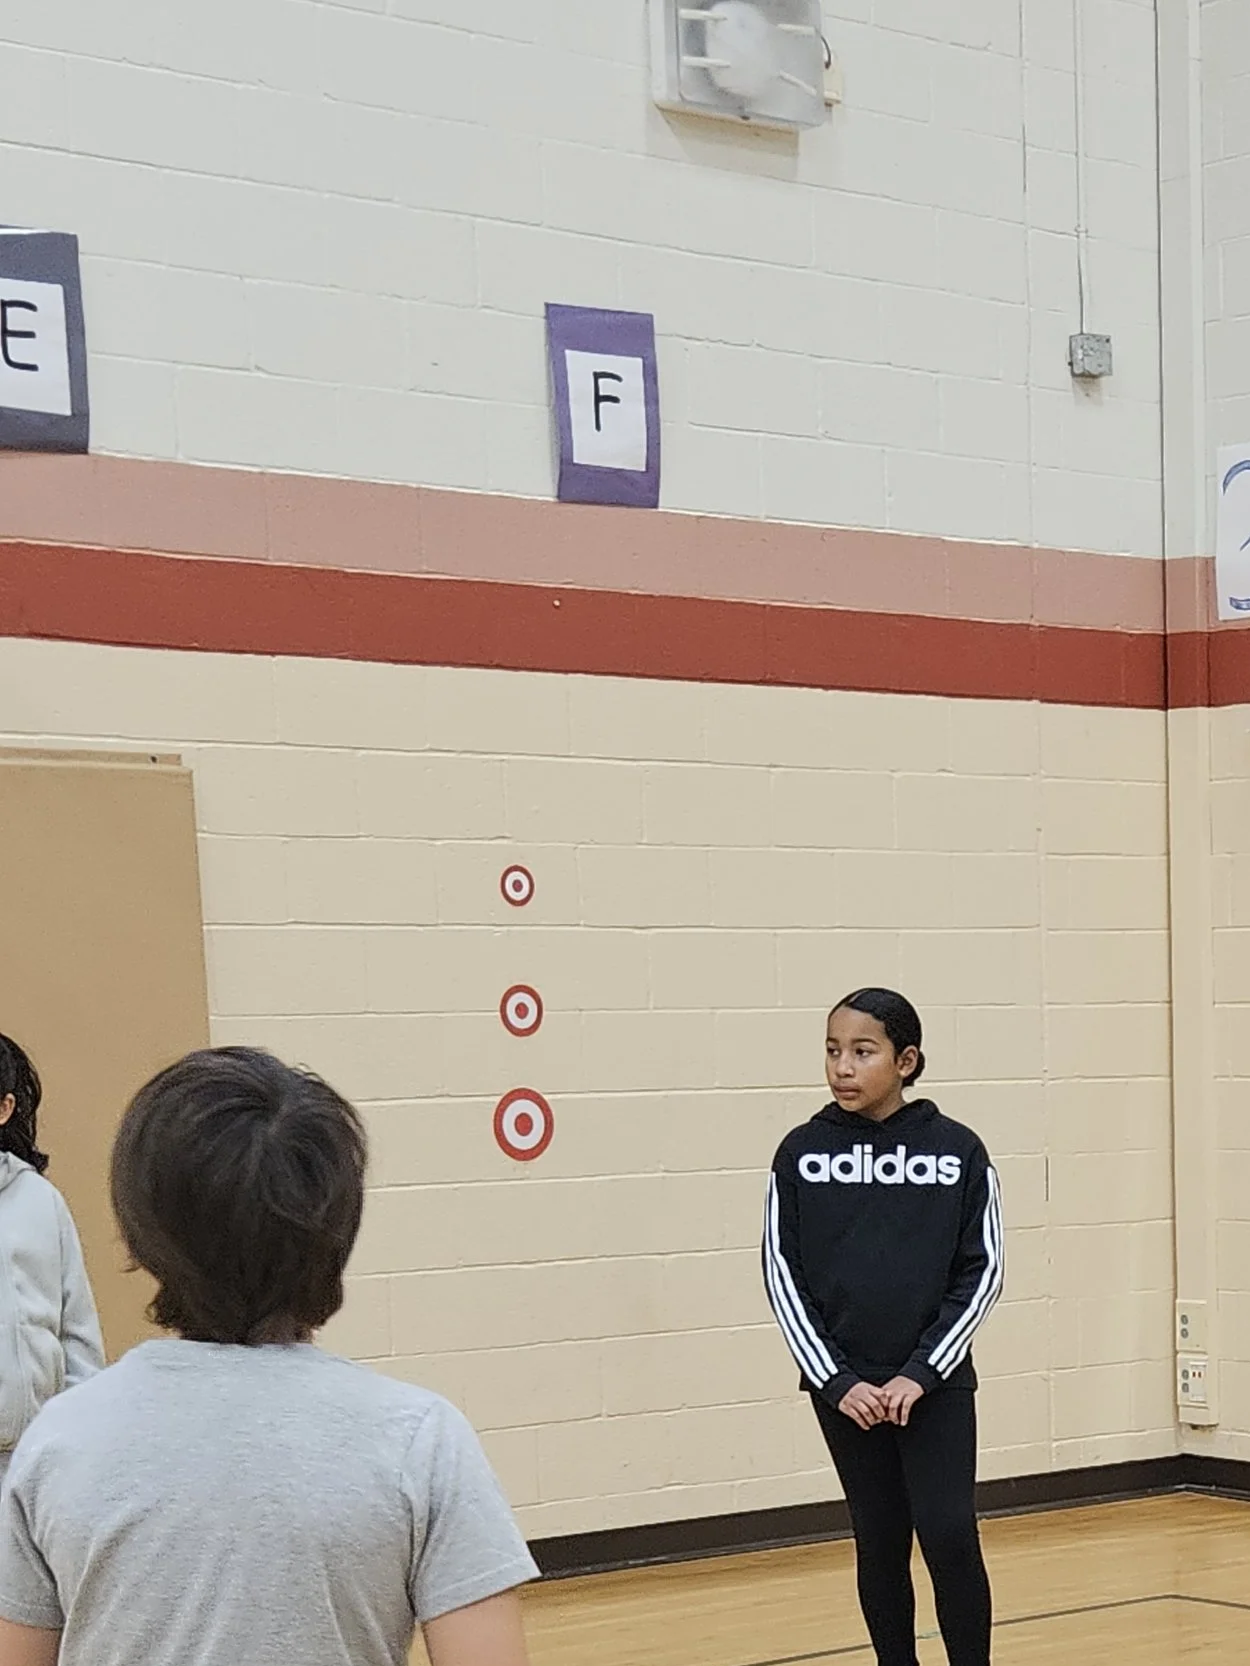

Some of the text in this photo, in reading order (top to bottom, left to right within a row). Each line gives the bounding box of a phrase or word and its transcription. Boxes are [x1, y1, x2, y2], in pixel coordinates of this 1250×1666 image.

[0, 299, 39, 371] E
[592, 371, 623, 432] F
[799, 1144, 962, 1185] adidas
